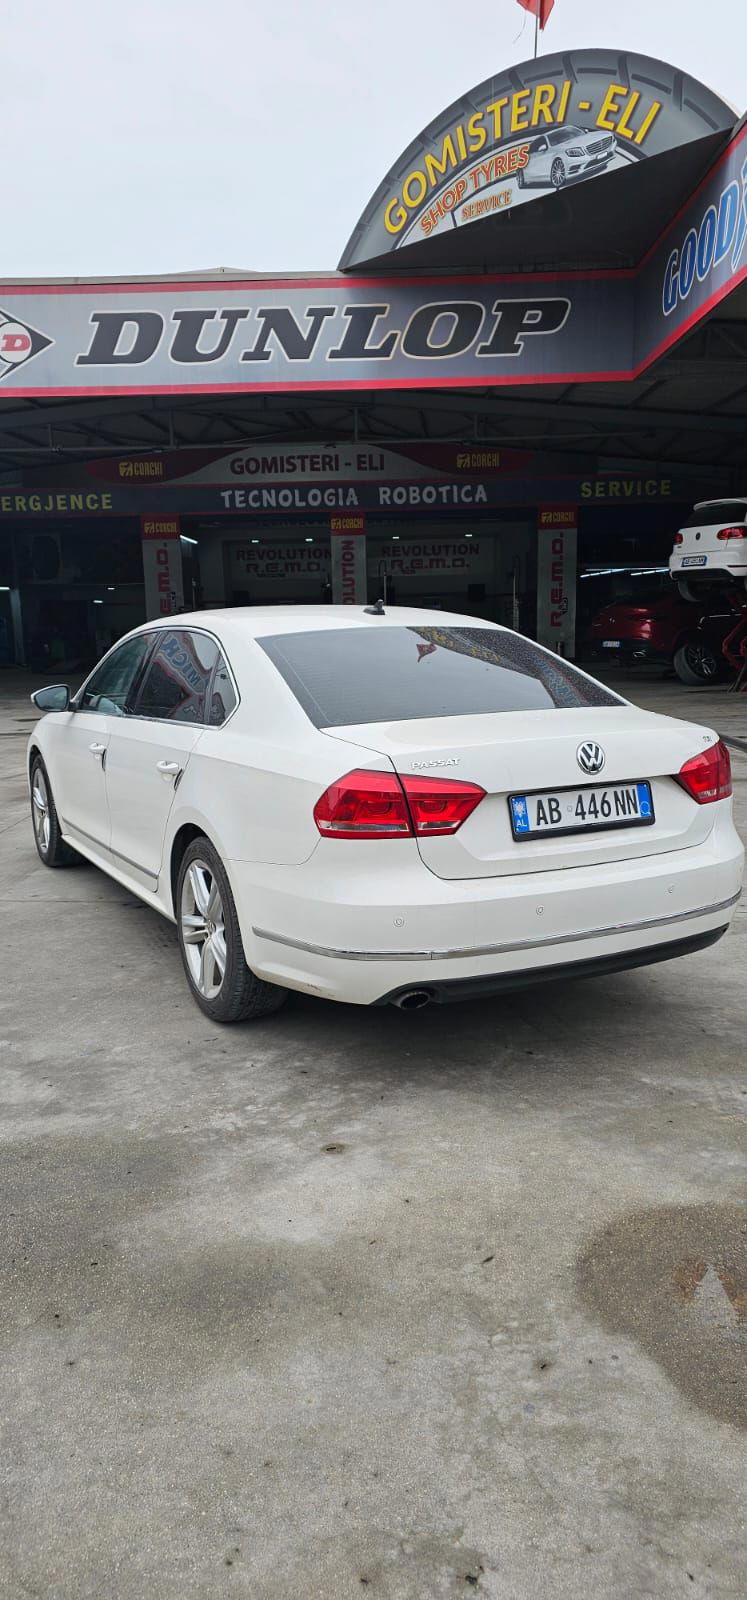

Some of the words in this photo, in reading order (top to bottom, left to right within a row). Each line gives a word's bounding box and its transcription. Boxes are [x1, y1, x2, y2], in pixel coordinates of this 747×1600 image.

[383, 80, 572, 235] GOMISTERI
[595, 84, 661, 145] ELI
[419, 175, 467, 235] SHOP
[469, 145, 530, 188] TYRES
[461, 189, 512, 221] SERVICE
[74, 298, 571, 367] DUNLOP
[230, 454, 339, 475] GOMISTERI
[357, 454, 385, 471] ELI
[220, 487, 359, 509] TECNOLOGIA
[378, 484, 488, 505] ROBOTICA
[580, 479, 671, 498] SERVICE
[236, 547, 332, 561] REVOLUTION
[382, 543, 480, 557] REVOLUTION
[411, 758, 461, 770] PASSAT
[516, 819, 527, 827] AL
[536, 797, 562, 826] AB
